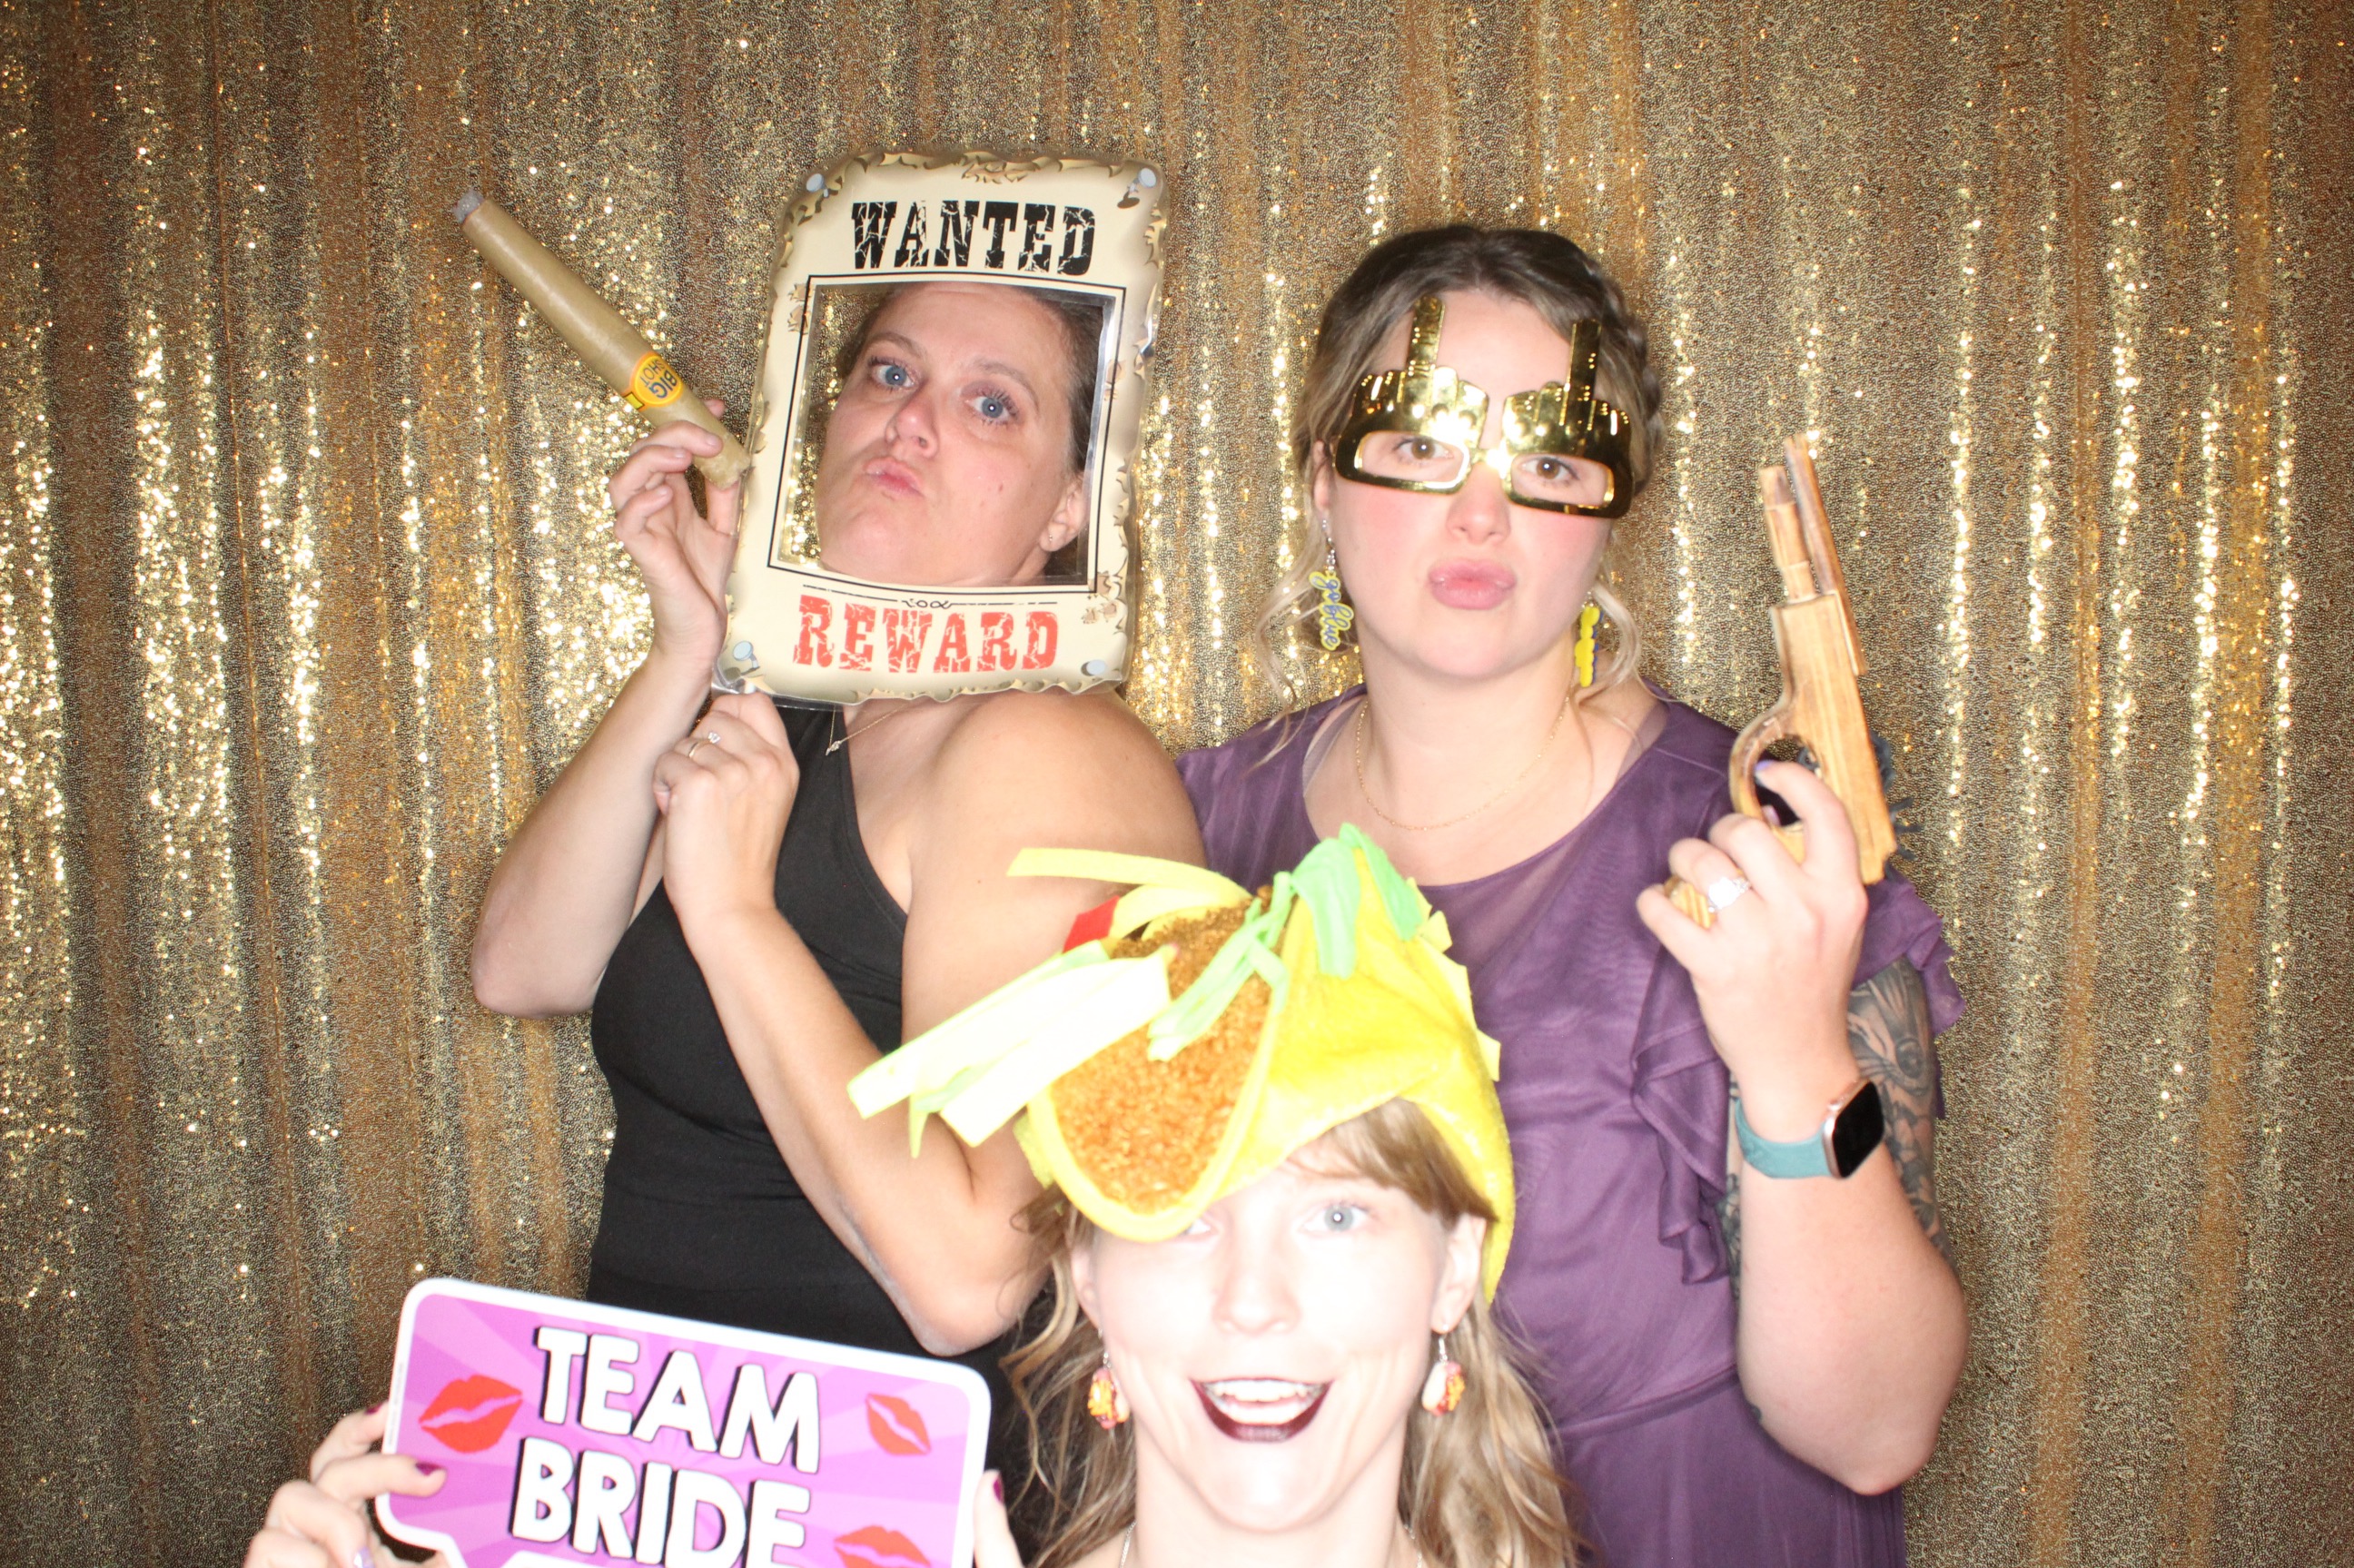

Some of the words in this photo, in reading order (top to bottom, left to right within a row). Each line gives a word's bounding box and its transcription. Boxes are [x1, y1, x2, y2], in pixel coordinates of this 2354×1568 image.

[852, 200, 1095, 276] WANTED
[639, 359, 665, 388] SHOT
[648, 370, 678, 399] BIG
[793, 595, 1058, 674] REWARD
[533, 1326, 821, 1475] TEAM
[508, 1436, 811, 1568] BRIDE
